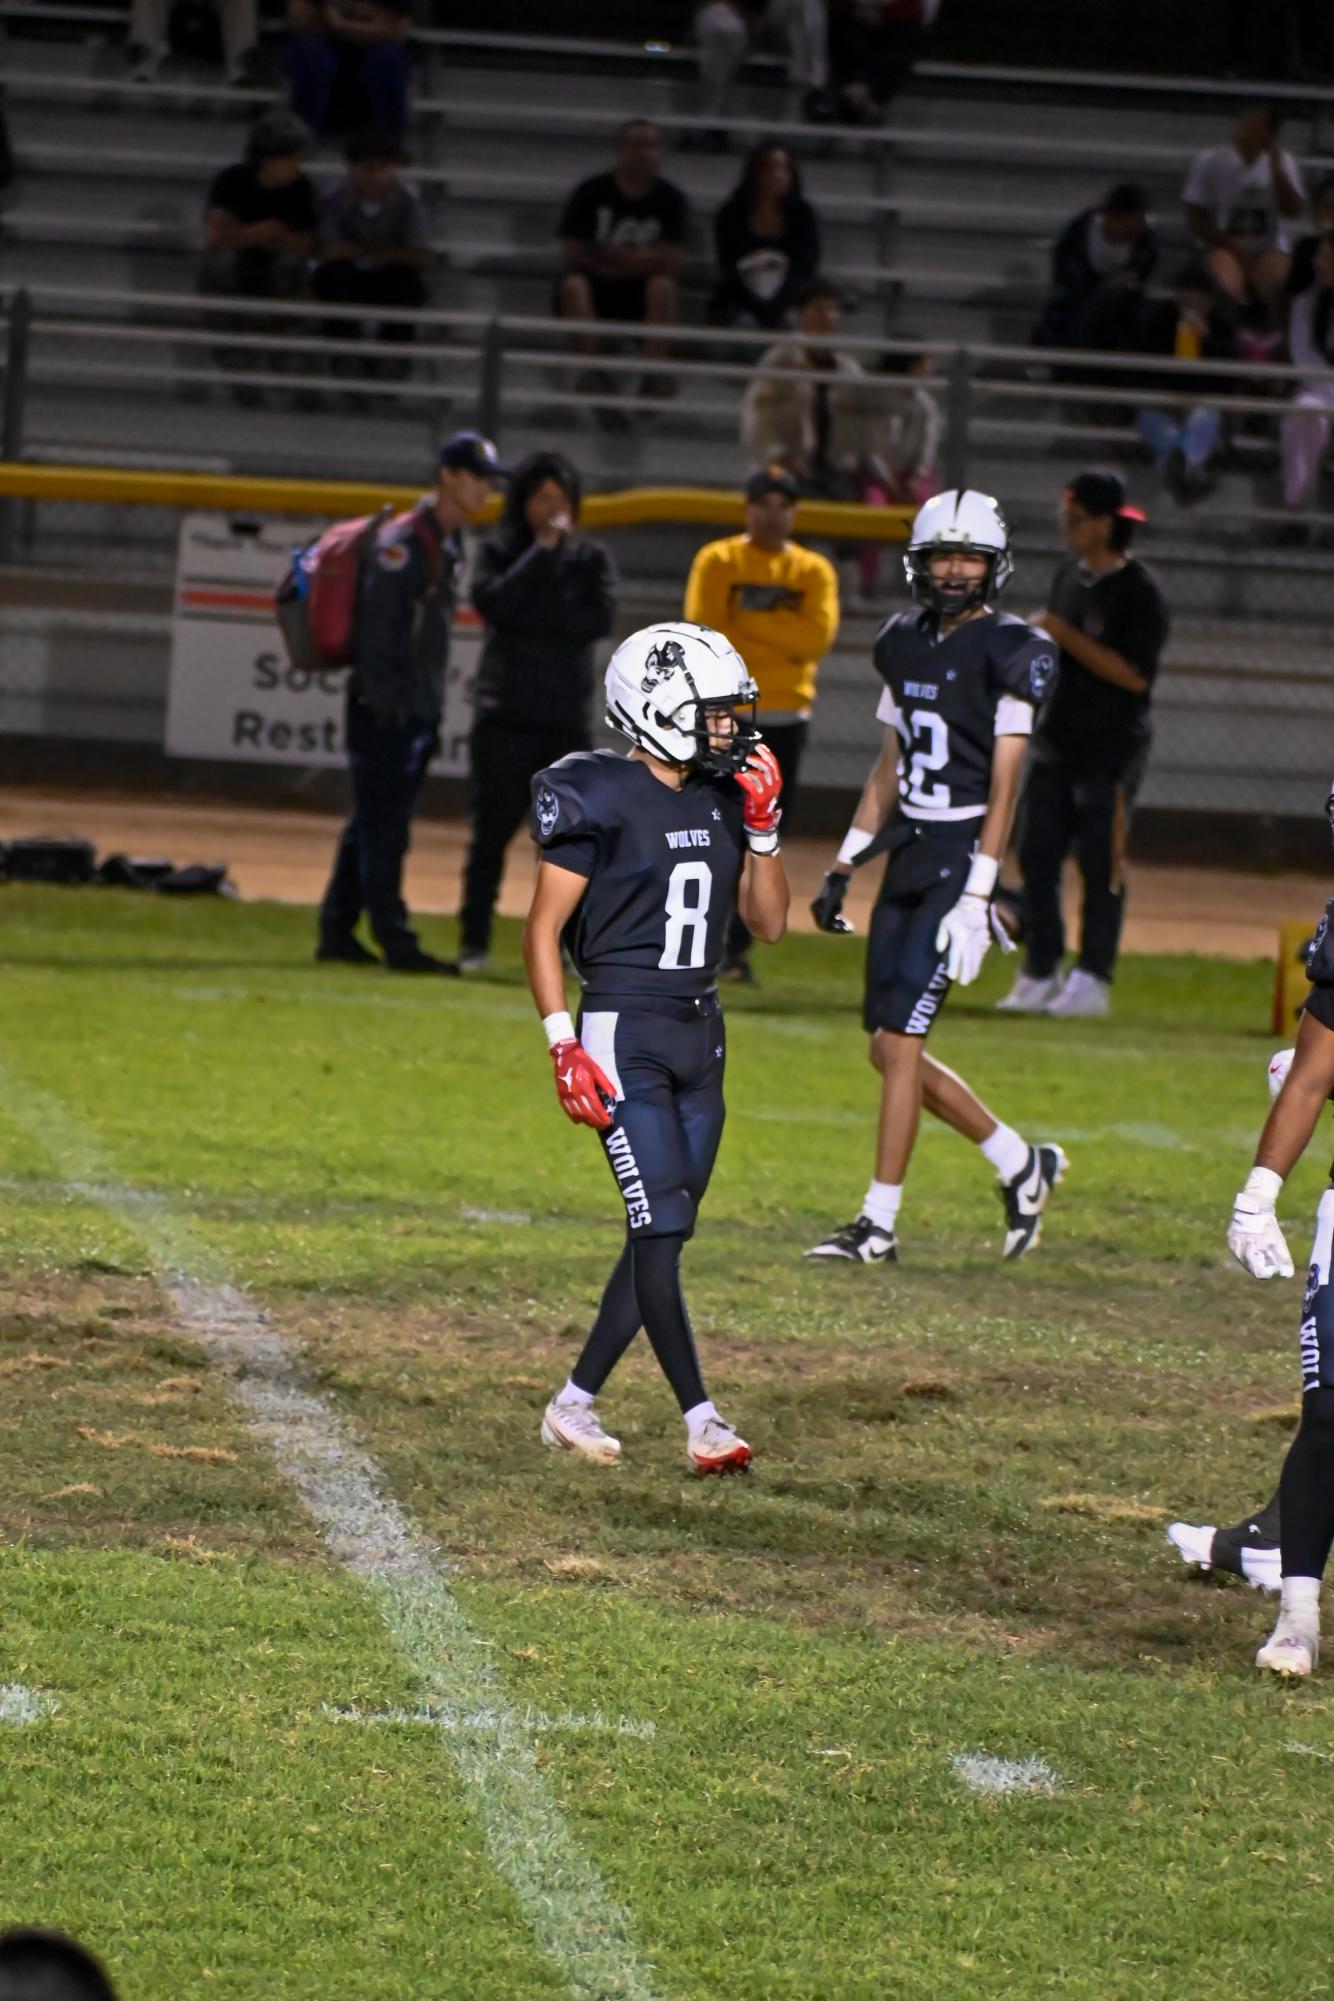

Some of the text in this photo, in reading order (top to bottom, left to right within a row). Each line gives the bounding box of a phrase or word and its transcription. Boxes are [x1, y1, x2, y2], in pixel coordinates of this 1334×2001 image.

[253, 653, 343, 695] Soc
[232, 709, 338, 751] Rest
[665, 829, 710, 849] WOLVES
[658, 861, 712, 970] 8
[904, 961, 947, 1034] WOLVE
[606, 1126, 652, 1229] WOLVES
[1300, 1316, 1320, 1392] WOL
